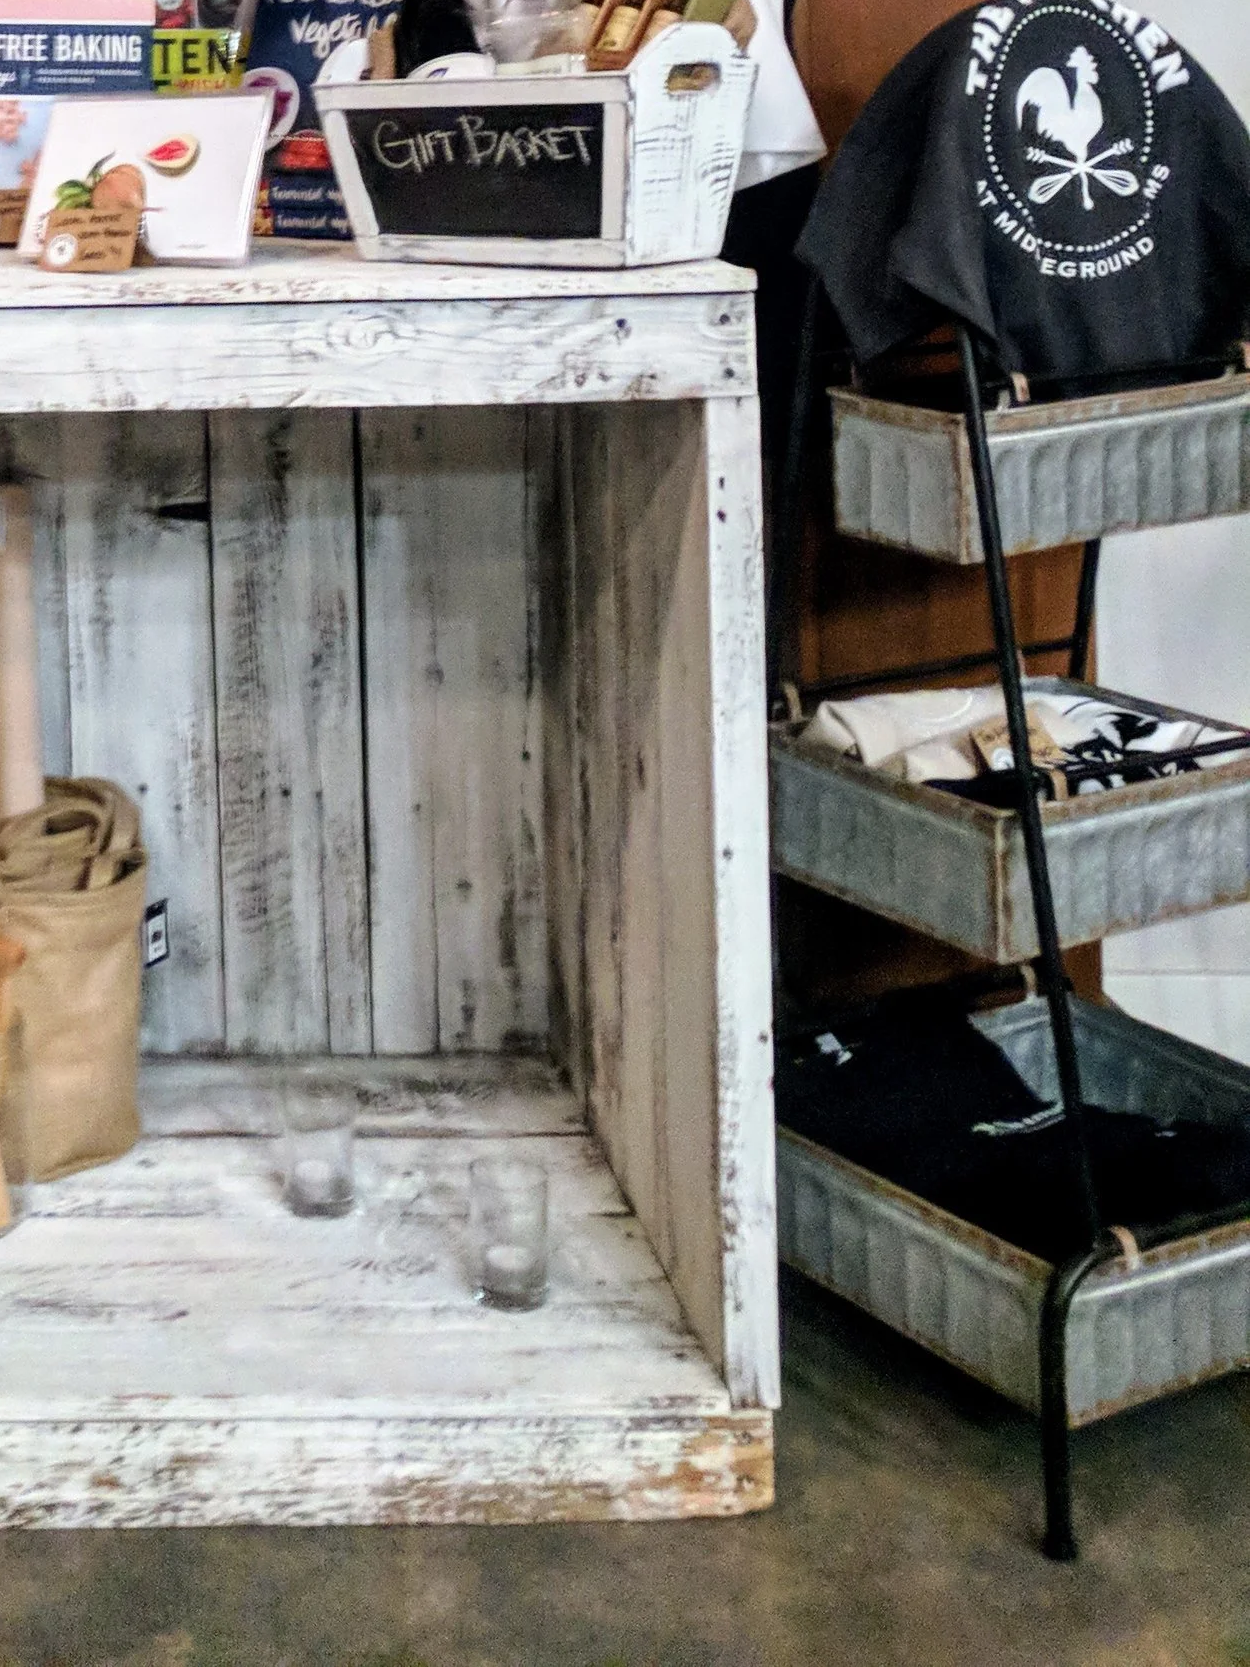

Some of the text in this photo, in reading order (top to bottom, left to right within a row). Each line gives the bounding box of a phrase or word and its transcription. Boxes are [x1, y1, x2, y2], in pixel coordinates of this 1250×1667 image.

[52, 34, 143, 63] BAKING
[373, 114, 594, 173] GIFT BASKET
